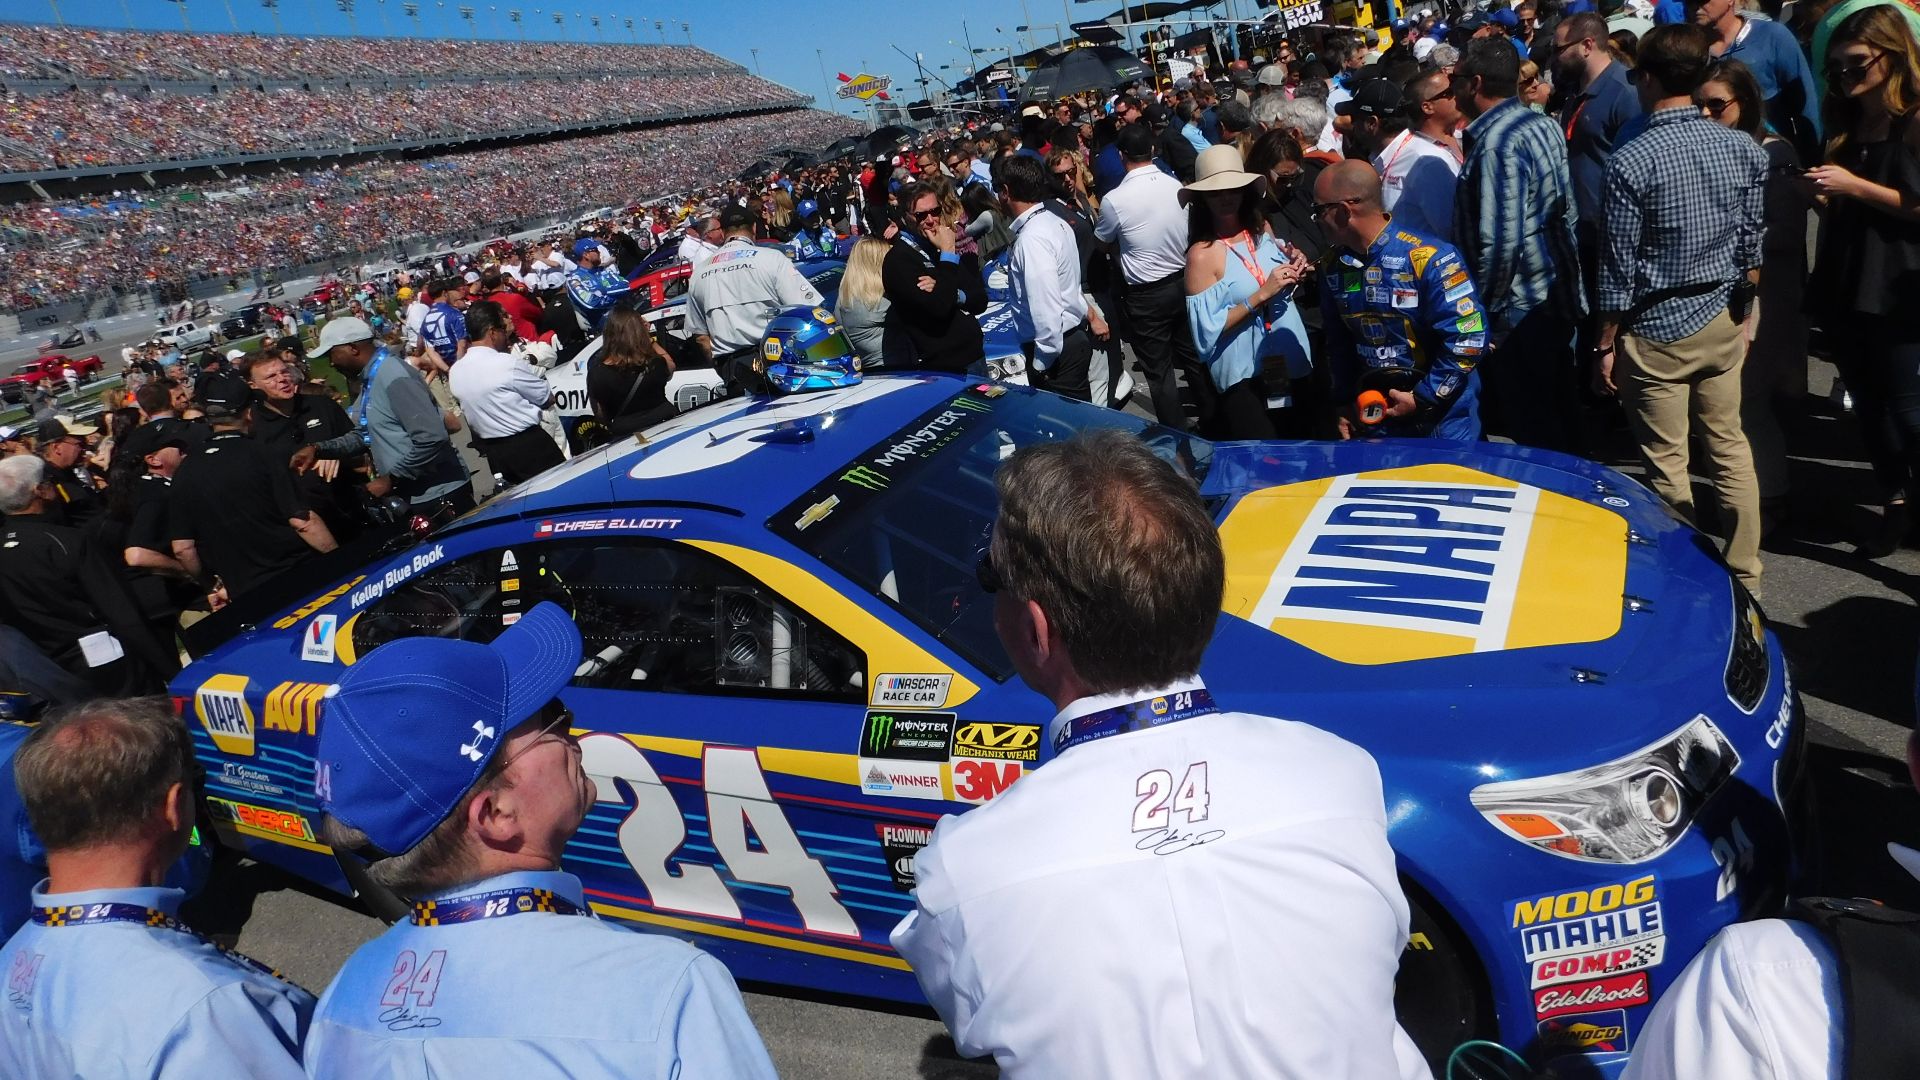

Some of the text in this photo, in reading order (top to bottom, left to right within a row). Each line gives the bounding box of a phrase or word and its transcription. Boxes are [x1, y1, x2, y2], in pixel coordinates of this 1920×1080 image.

[1284, 1, 1320, 20] EXIT
[1287, 11, 1323, 30] NOW
[841, 78, 888, 96] SUNOCO
[1396, 231, 1422, 247] NAPA
[701, 263, 756, 279] OFFICIAL
[874, 409, 967, 466] MONSTER
[920, 426, 965, 459] ENERGY
[554, 518, 682, 533] CHASE ELLIOTT
[1281, 486, 1517, 626] NAPA
[351, 544, 445, 610] Kelley Blue Book
[897, 678, 939, 690] NASCAR
[883, 692, 936, 702] RACE CAR
[1175, 691, 1192, 711] 24
[202, 694, 250, 735] NAPA
[264, 681, 325, 736] AUT
[895, 720, 948, 733] MONSTER
[1060, 721, 1072, 743] 24
[954, 743, 1037, 761] MECHANIX WEAR
[315, 760, 332, 801] 24
[889, 773, 939, 788] WINNER
[954, 761, 1021, 800] 3M
[1132, 761, 1210, 833] 24
[577, 732, 862, 940] 24
[88, 904, 113, 918] 24
[484, 897, 510, 917] 24
[1513, 875, 1655, 928] MOOG
[1524, 905, 1659, 955] MAHLE
[1536, 948, 1632, 981] COMP
[1602, 959, 1648, 974] CAMS
[380, 950, 447, 1007] 24
[1537, 980, 1647, 1013] Edelbrock
